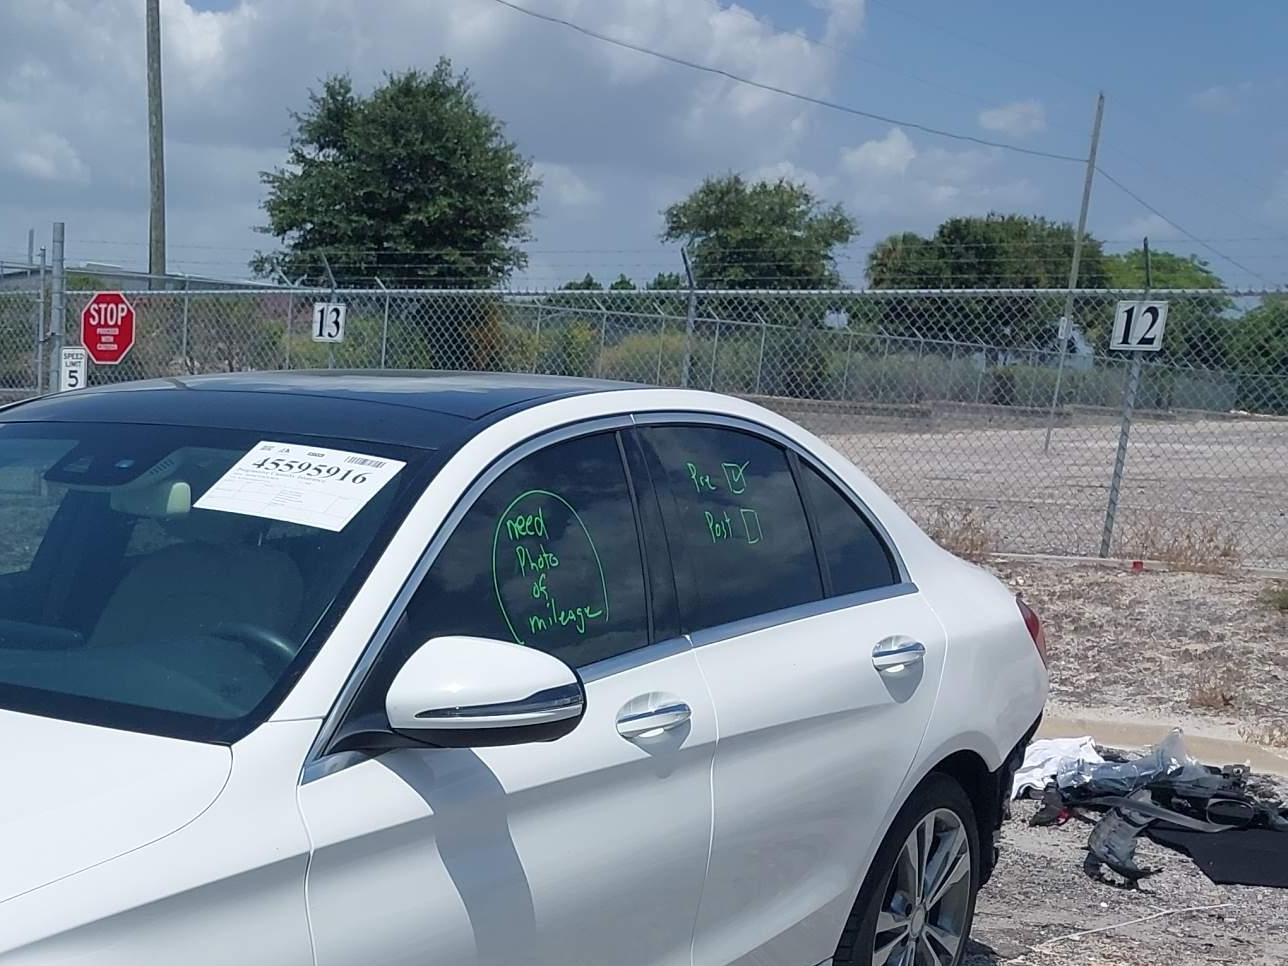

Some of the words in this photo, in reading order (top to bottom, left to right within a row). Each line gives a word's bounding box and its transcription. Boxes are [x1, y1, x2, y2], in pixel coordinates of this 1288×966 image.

[89, 303, 127, 325] STOP
[315, 307, 340, 338] 13
[1117, 306, 1159, 345] 12
[63, 352, 84, 360] SPEED
[68, 370, 79, 388] 5
[252, 457, 373, 484] 45595916
[507, 508, 549, 540] need
[705, 511, 734, 543] Post
[532, 574, 548, 601] of
[529, 598, 602, 634] mileage
